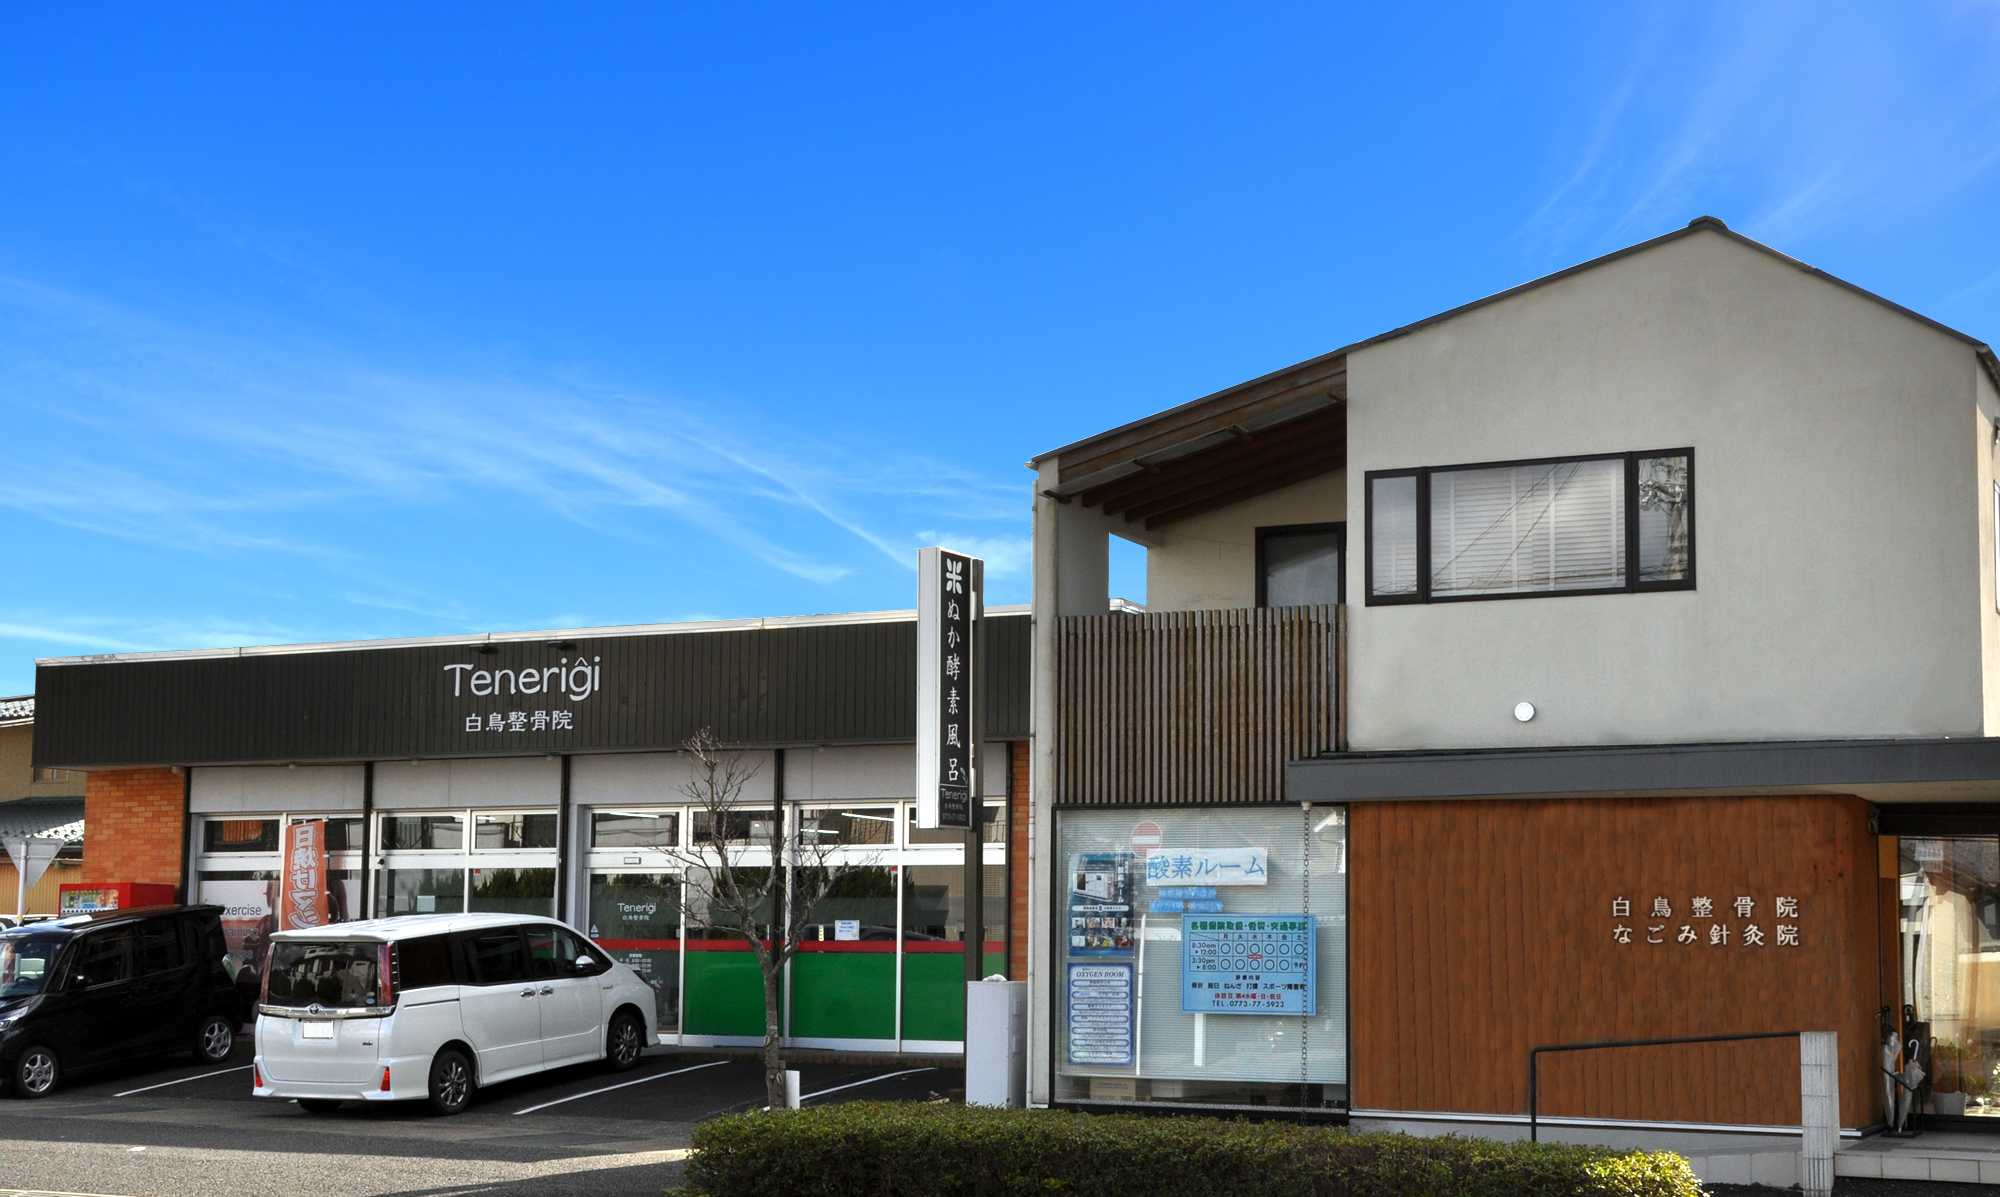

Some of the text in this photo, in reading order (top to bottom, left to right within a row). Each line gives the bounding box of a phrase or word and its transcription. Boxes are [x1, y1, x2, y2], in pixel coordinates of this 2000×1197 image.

[946, 599, 961, 782] ぬか酵素風呂
[465, 710, 574, 732] 白鳥整骨院
[1147, 855, 1265, 879] 酸素ルーム
[223, 904, 262, 916] xercise
[1612, 896, 1798, 918] 白鳥整骨院
[224, 926, 260, 941] raining
[1613, 924, 1799, 946] なごみ針灸院
